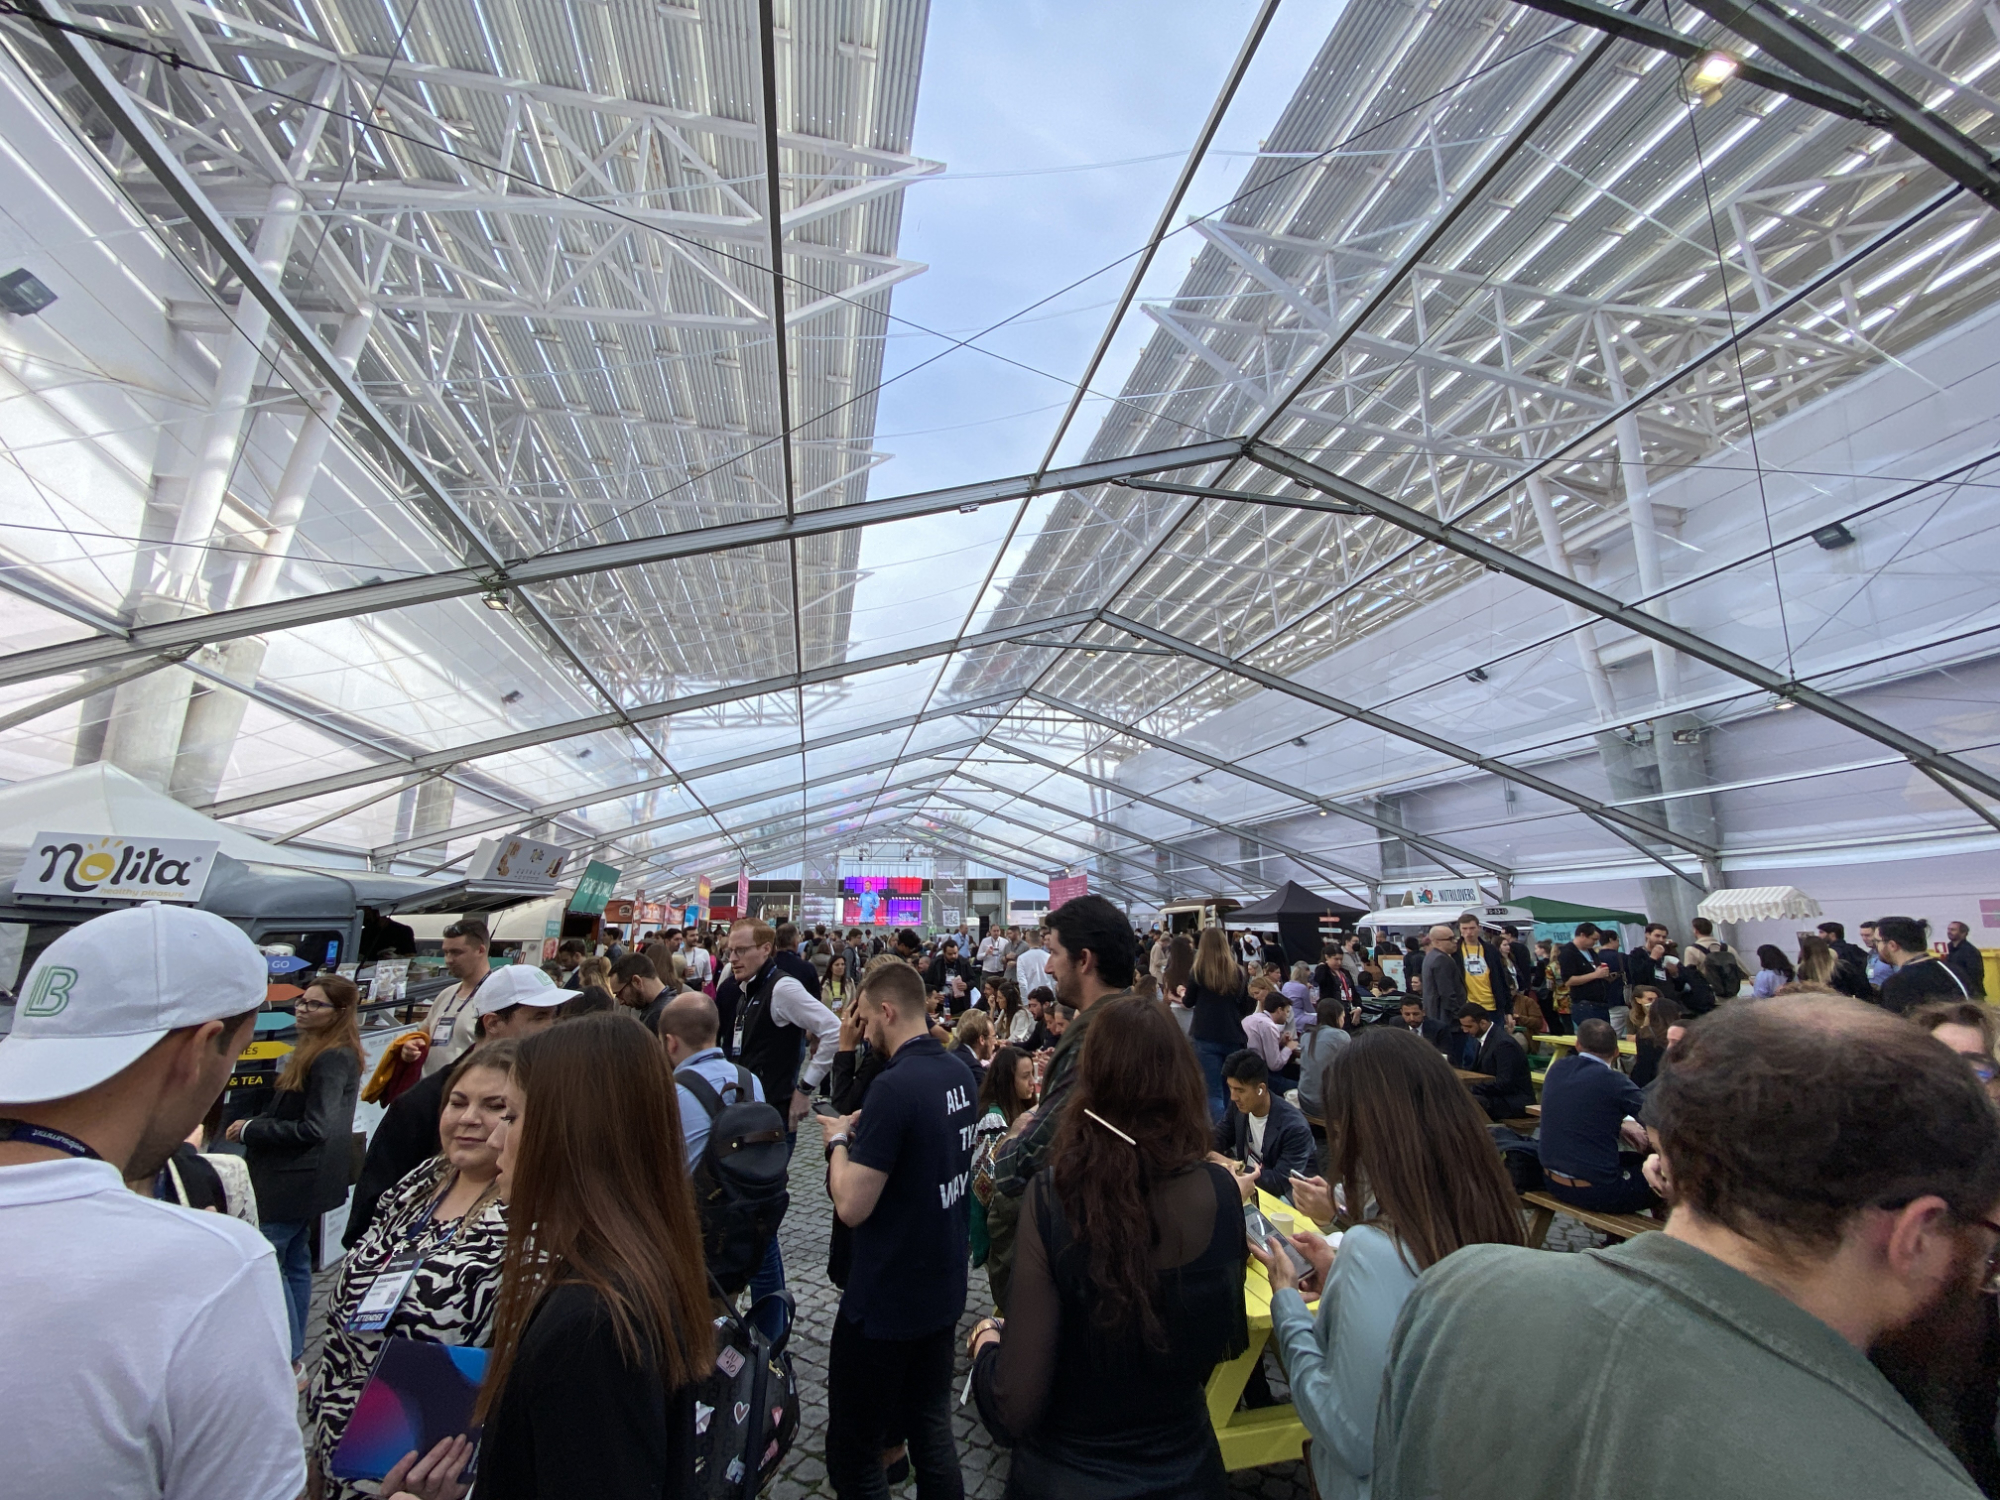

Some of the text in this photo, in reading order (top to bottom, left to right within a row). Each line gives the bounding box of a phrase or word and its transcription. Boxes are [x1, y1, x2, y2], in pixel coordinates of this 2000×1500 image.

[100, 886, 185, 899] healthy pleasure
[1438, 888, 1476, 902] NUTRILOVERS
[271, 960, 290, 969] GO
[229, 1075, 264, 1087] & TEA
[946, 1085, 971, 1115] ALL
[354, 1313, 384, 1322] ATTENDEE
[725, 1348, 738, 1362] LIU
